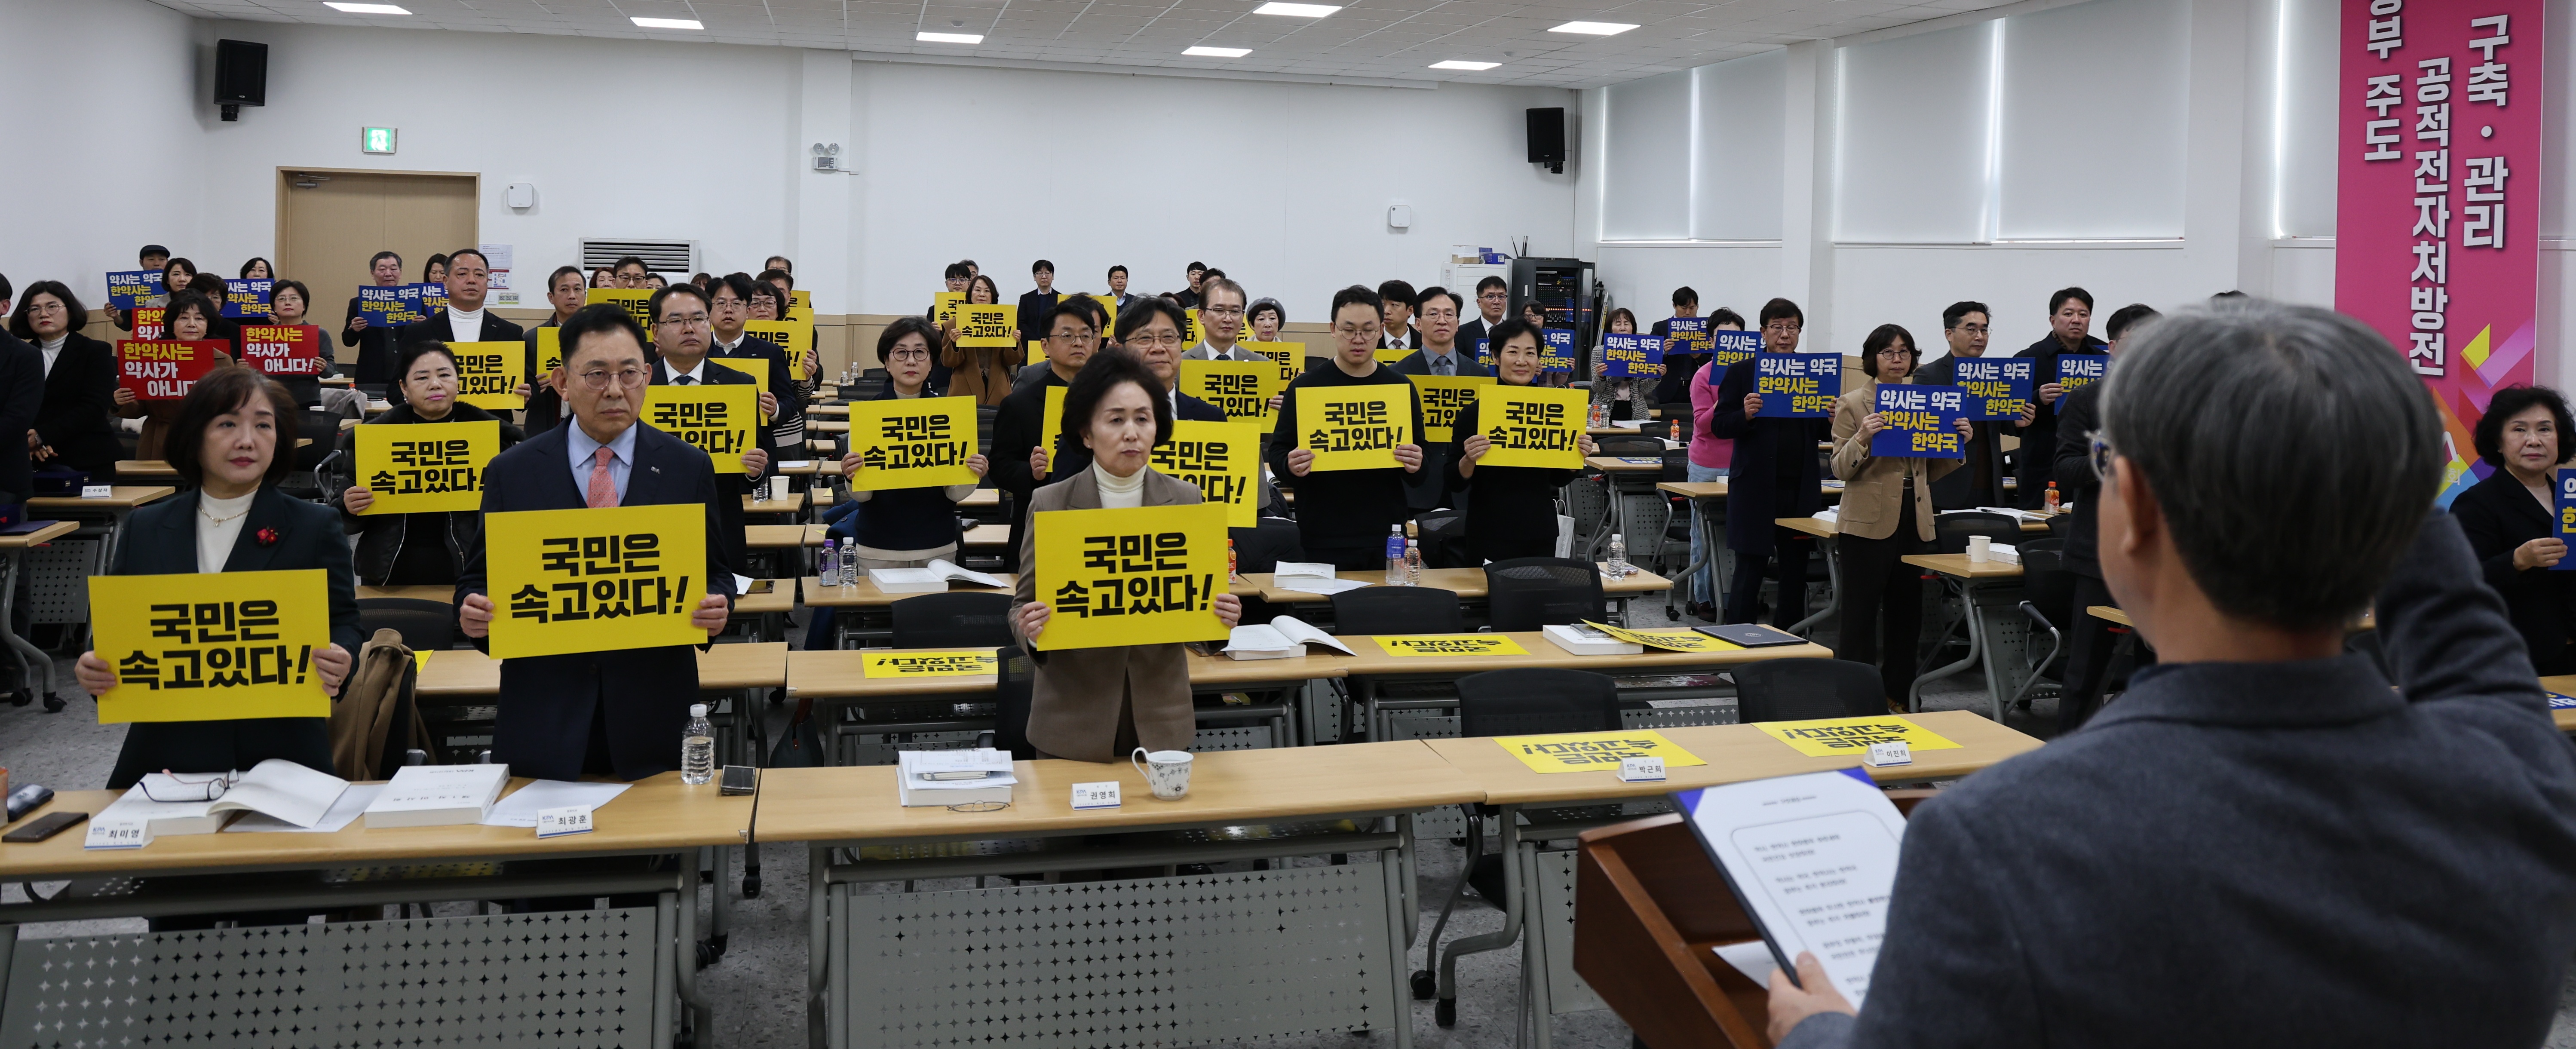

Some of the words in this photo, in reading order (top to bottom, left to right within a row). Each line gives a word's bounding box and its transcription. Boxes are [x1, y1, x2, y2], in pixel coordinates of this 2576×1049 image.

[2467, 14, 2510, 106] 구축
[2364, 74, 2401, 161] 주도
[2463, 156, 2509, 248] 관리
[2409, 56, 2451, 377] 공적전자처방전
[109, 273, 141, 285] 약사는
[143, 272, 163, 283] 약국
[226, 282, 248, 292] 사는
[251, 281, 271, 292] 약국
[110, 285, 151, 297] 한약사는
[227, 293, 259, 304] 약사는
[362, 289, 395, 301] 약사는
[398, 288, 419, 300] 약국
[421, 286, 442, 296] 사는
[241, 303, 272, 314] 한약국
[362, 301, 405, 312] 한약사는
[386, 310, 417, 324] 한약국
[971, 312, 1004, 325] 국민은
[1671, 320, 1698, 331] 약사는
[246, 327, 303, 342] 한약사는
[962, 325, 1012, 338] 속고있다!
[1550, 333, 1570, 344] 약국
[1671, 331, 1707, 341] 한약사는
[123, 342, 193, 360] 한약사는
[246, 343, 290, 357] 약사가
[1607, 337, 1638, 350] 약사는
[1640, 338, 1660, 351] 약국
[1719, 335, 1757, 351] 약사는
[1606, 349, 1647, 362] 한약사는
[125, 362, 178, 379] 약사가
[264, 358, 314, 372] 아니다!
[1628, 362, 1658, 375] 한약국
[1760, 358, 1806, 376] 약사는
[1810, 358, 1837, 376] 약국
[1958, 363, 1999, 380] 약사는
[2003, 363, 2030, 380] 약국
[2062, 359, 2103, 376] 약사는
[1204, 374, 1258, 395] 국민은
[1759, 376, 1819, 394] 한약사는
[1423, 388, 1475, 408] 국민은
[1792, 395, 1835, 413] 한약국
[1880, 390, 1926, 410] 약사는
[1931, 392, 1962, 411] 약국
[654, 402, 727, 428] 국민은
[1325, 401, 1387, 426] 국민은
[1506, 401, 1564, 426] 국민은
[1985, 399, 2026, 416] 한약국
[881, 414, 951, 442] 국민은
[1879, 410, 1940, 431] 한약사는
[1309, 426, 1403, 453] 속고있다!
[1488, 426, 1577, 451] 속고있다!
[1912, 432, 1958, 453] 한약국
[391, 439, 470, 467] 국민은
[864, 441, 968, 470] 속고있다!
[1150, 441, 1229, 471] 국민은
[541, 533, 661, 577] 국민은
[1083, 531, 1188, 574] 국민은
[510, 575, 689, 624] 속고있다!
[1055, 573, 1214, 619] 속고있다!
[150, 599, 280, 644] 국민은
[119, 644, 312, 690] 속고있다!
[1782, 724, 1910, 739] 속고있다!
[1522, 739, 1659, 755] 속고있다!
